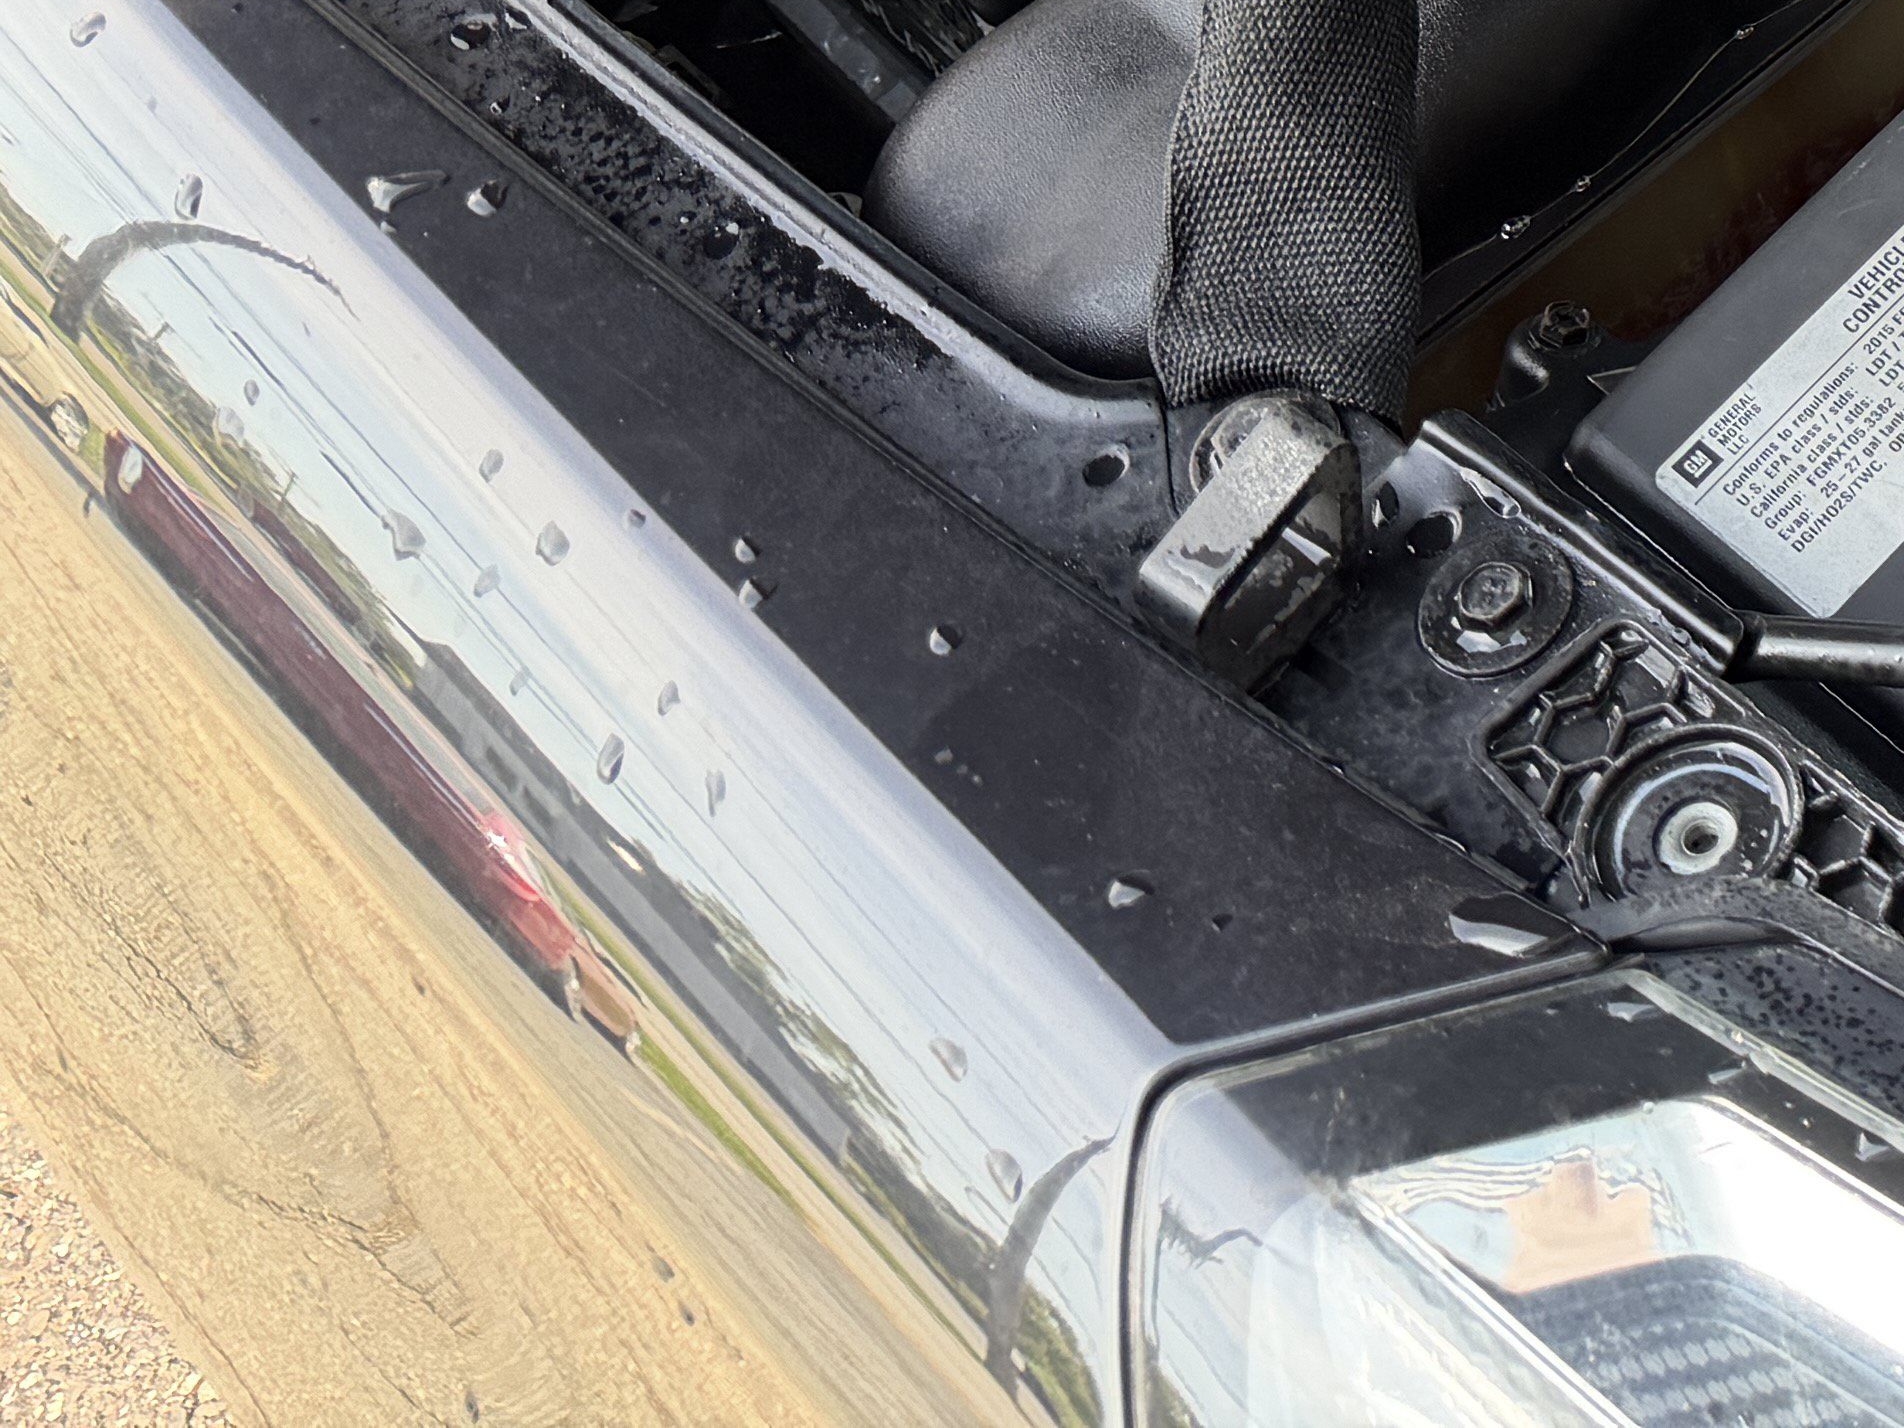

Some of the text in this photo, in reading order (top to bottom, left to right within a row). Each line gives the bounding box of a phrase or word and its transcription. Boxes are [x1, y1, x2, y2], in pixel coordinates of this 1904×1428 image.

[1707, 392, 1756, 438] GENERAL
[1716, 402, 1761, 447] MOTORS
[1722, 441, 1779, 496] Conforms
[1776, 427, 1792, 442] to
[1791, 361, 1858, 428] regulations:
[1862, 323, 1895, 355] 2015
[1735, 481, 1766, 506] U.S.
[1763, 453, 1792, 479] EPA
[1790, 422, 1822, 454] class
[1819, 412, 1829, 424] /
[1828, 386, 1858, 415] stds:
[1864, 348, 1892, 376] LDT
[1891, 340, 1901, 352] /
[1683, 449, 1709, 474] GM
[1726, 433, 1749, 455] LLC
[1749, 463, 1807, 518] California
[1805, 432, 1837, 463] class
[1835, 421, 1844, 433] /
[1843, 395, 1873, 425] stds:
[1763, 489, 1806, 529] Group:
[1776, 507, 1813, 541] Evap:
[1861, 435, 1882, 458] gal
